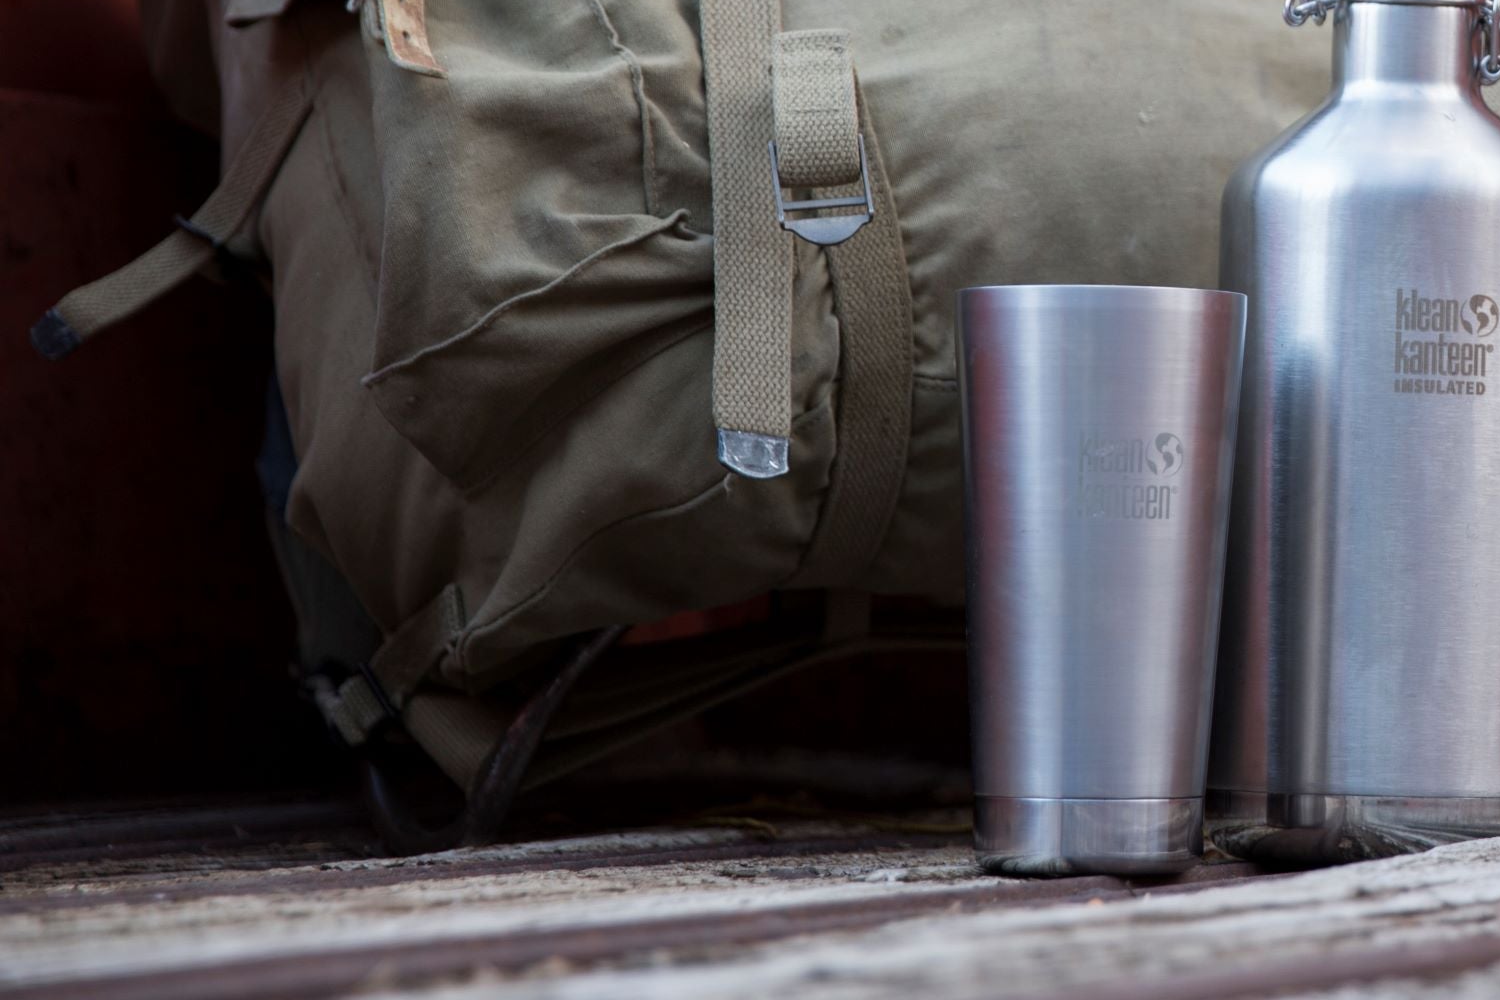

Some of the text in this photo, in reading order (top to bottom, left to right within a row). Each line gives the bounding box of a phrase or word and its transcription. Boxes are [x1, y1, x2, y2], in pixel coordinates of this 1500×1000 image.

[1395, 288, 1460, 333] klean
[1394, 331, 1486, 377] kanteen
[1394, 379, 1486, 396] INSULATED
